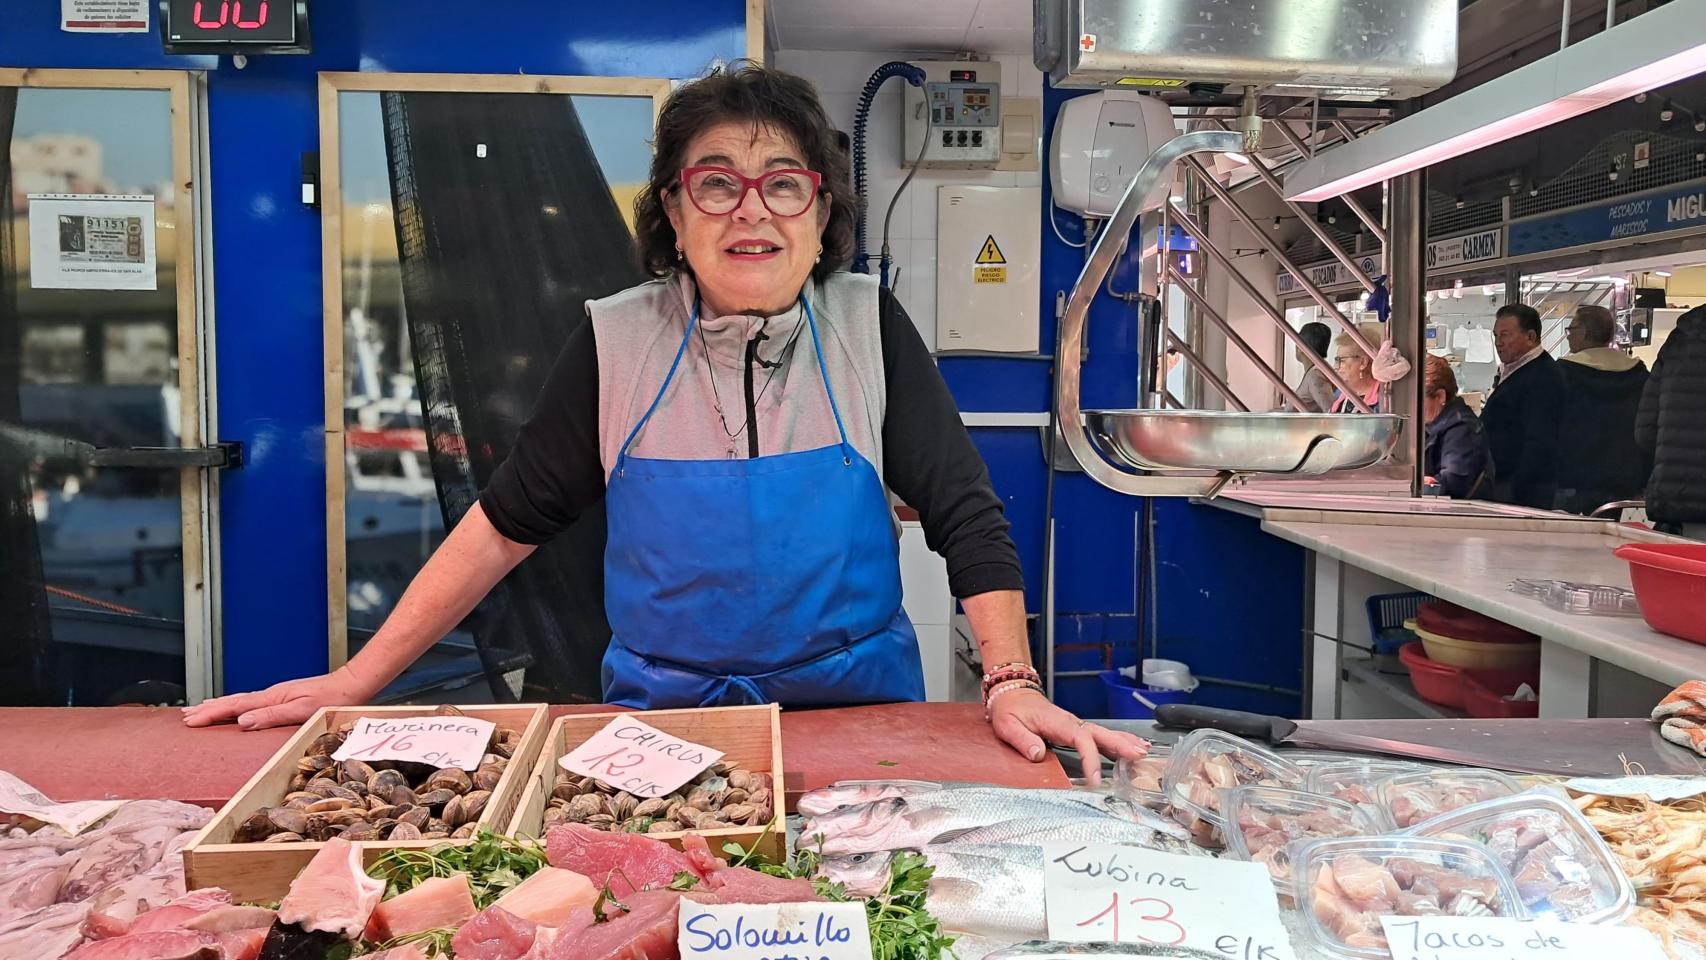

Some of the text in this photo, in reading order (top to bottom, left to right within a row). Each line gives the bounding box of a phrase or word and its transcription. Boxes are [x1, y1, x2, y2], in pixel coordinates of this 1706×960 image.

[1608, 199, 1652, 220] PESCADOS Y
[87, 219, 124, 229] 91151
[1610, 218, 1649, 238] MARISCOS
[1463, 232, 1497, 261] CARMEN
[364, 722, 480, 737] Marinera
[351, 734, 416, 757] 16
[582, 746, 645, 776] 12
[1053, 846, 1200, 891] Lubina
[1076, 891, 1187, 945] 13
[1391, 920, 1567, 952] Tacos de
